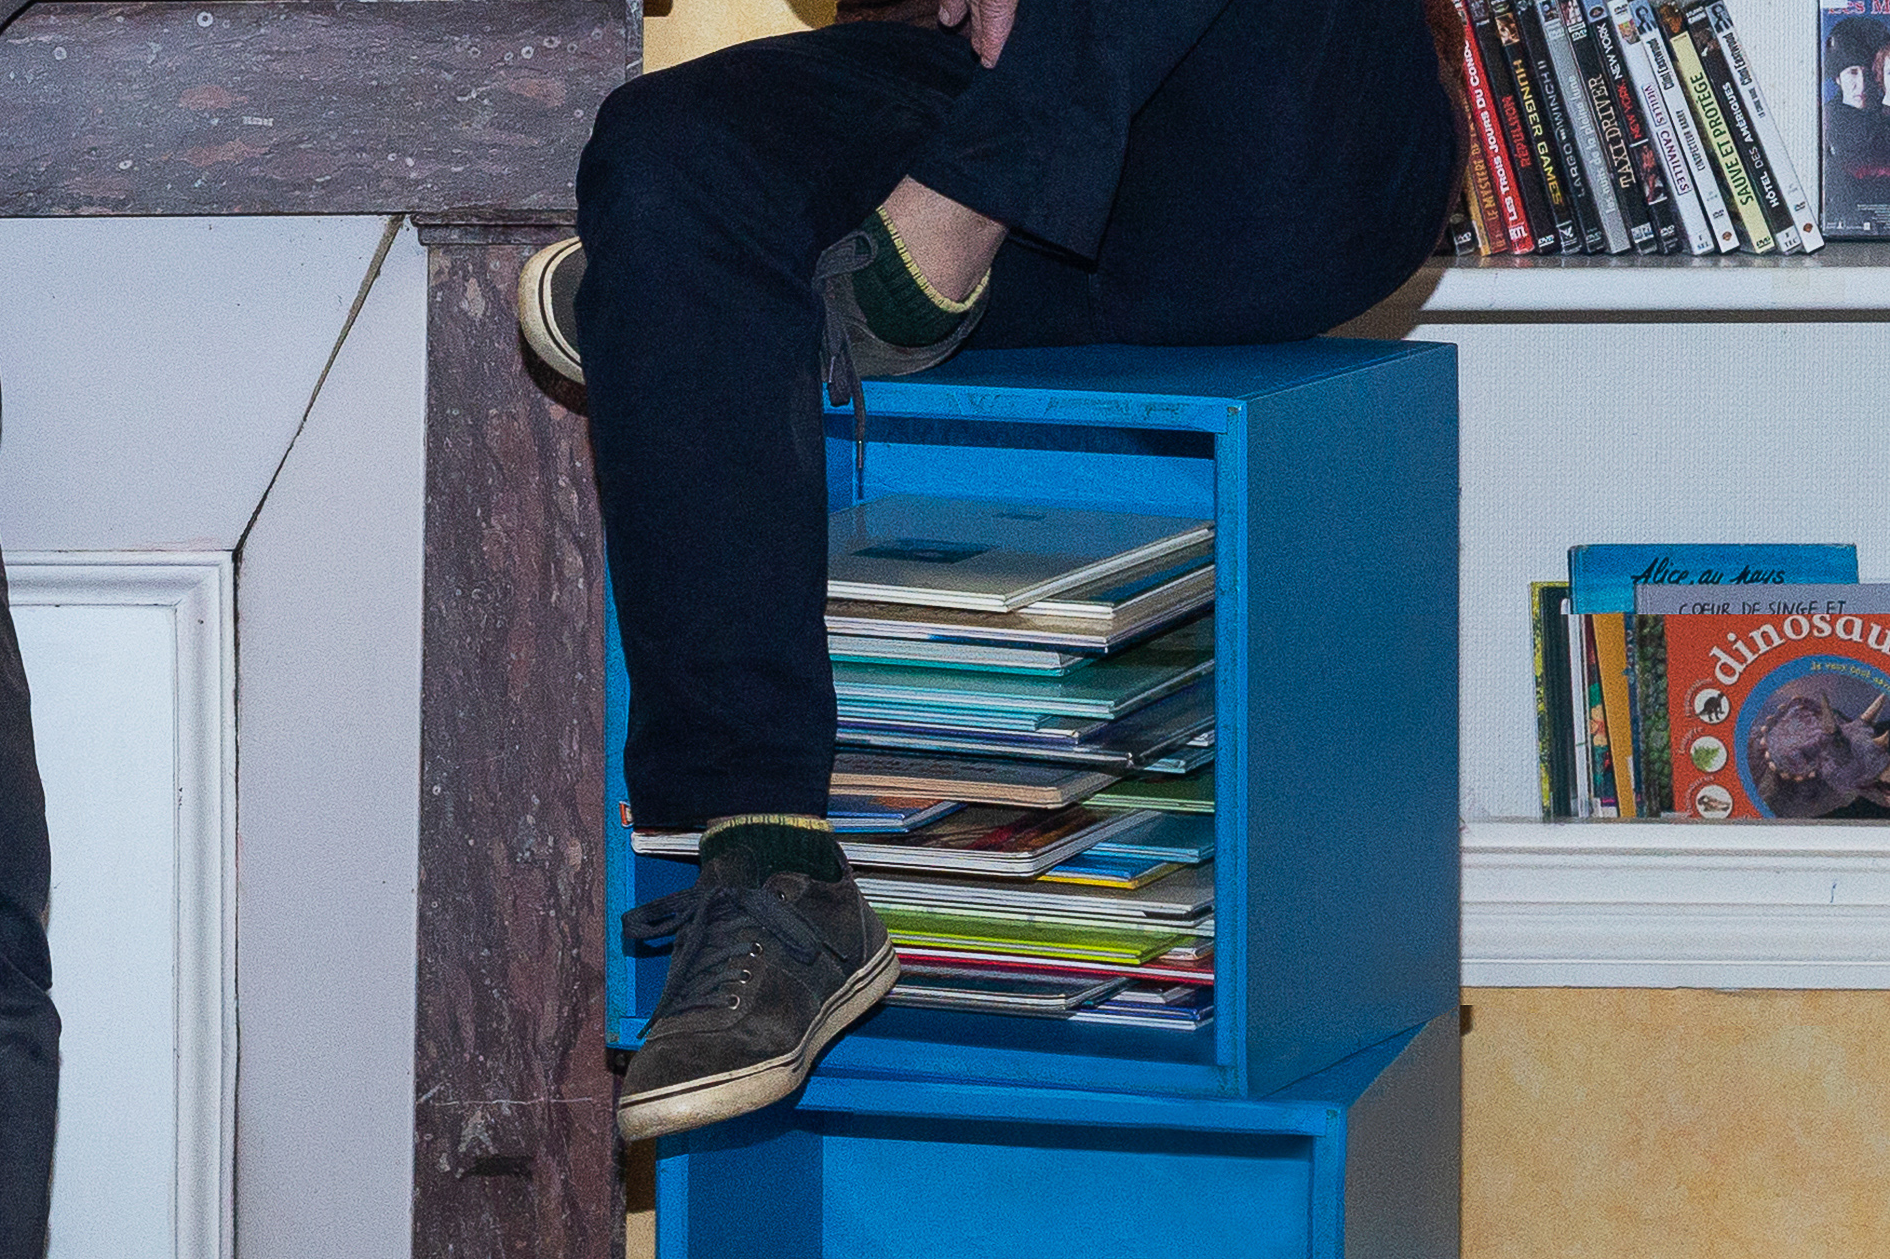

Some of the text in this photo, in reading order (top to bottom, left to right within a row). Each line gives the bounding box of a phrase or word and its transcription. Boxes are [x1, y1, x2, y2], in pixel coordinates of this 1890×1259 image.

[1595, 21, 1615, 52] YORK
[1605, 51, 1624, 80] NEW
[1539, 71, 1564, 125] WINCH
[1718, 80, 1754, 145] AMÉRIQUES
[1458, 39, 1518, 221] LES TROIS JOURS DU COND
[1509, 58, 1566, 206] HUNGER GAMES
[1586, 72, 1637, 188] TAXI DRIVER
[1626, 112, 1643, 139] NEW
[1658, 128, 1690, 192] CANAILLES
[1715, 137, 1735, 158] ET
[1747, 144, 1764, 168] DES
[1561, 142, 1587, 198] LARGO
[1723, 157, 1754, 206] SAUVE
[1755, 170, 1780, 208] HÔTEL
[1698, 568, 1725, 585] au
[1677, 601, 1735, 614] COEUR
